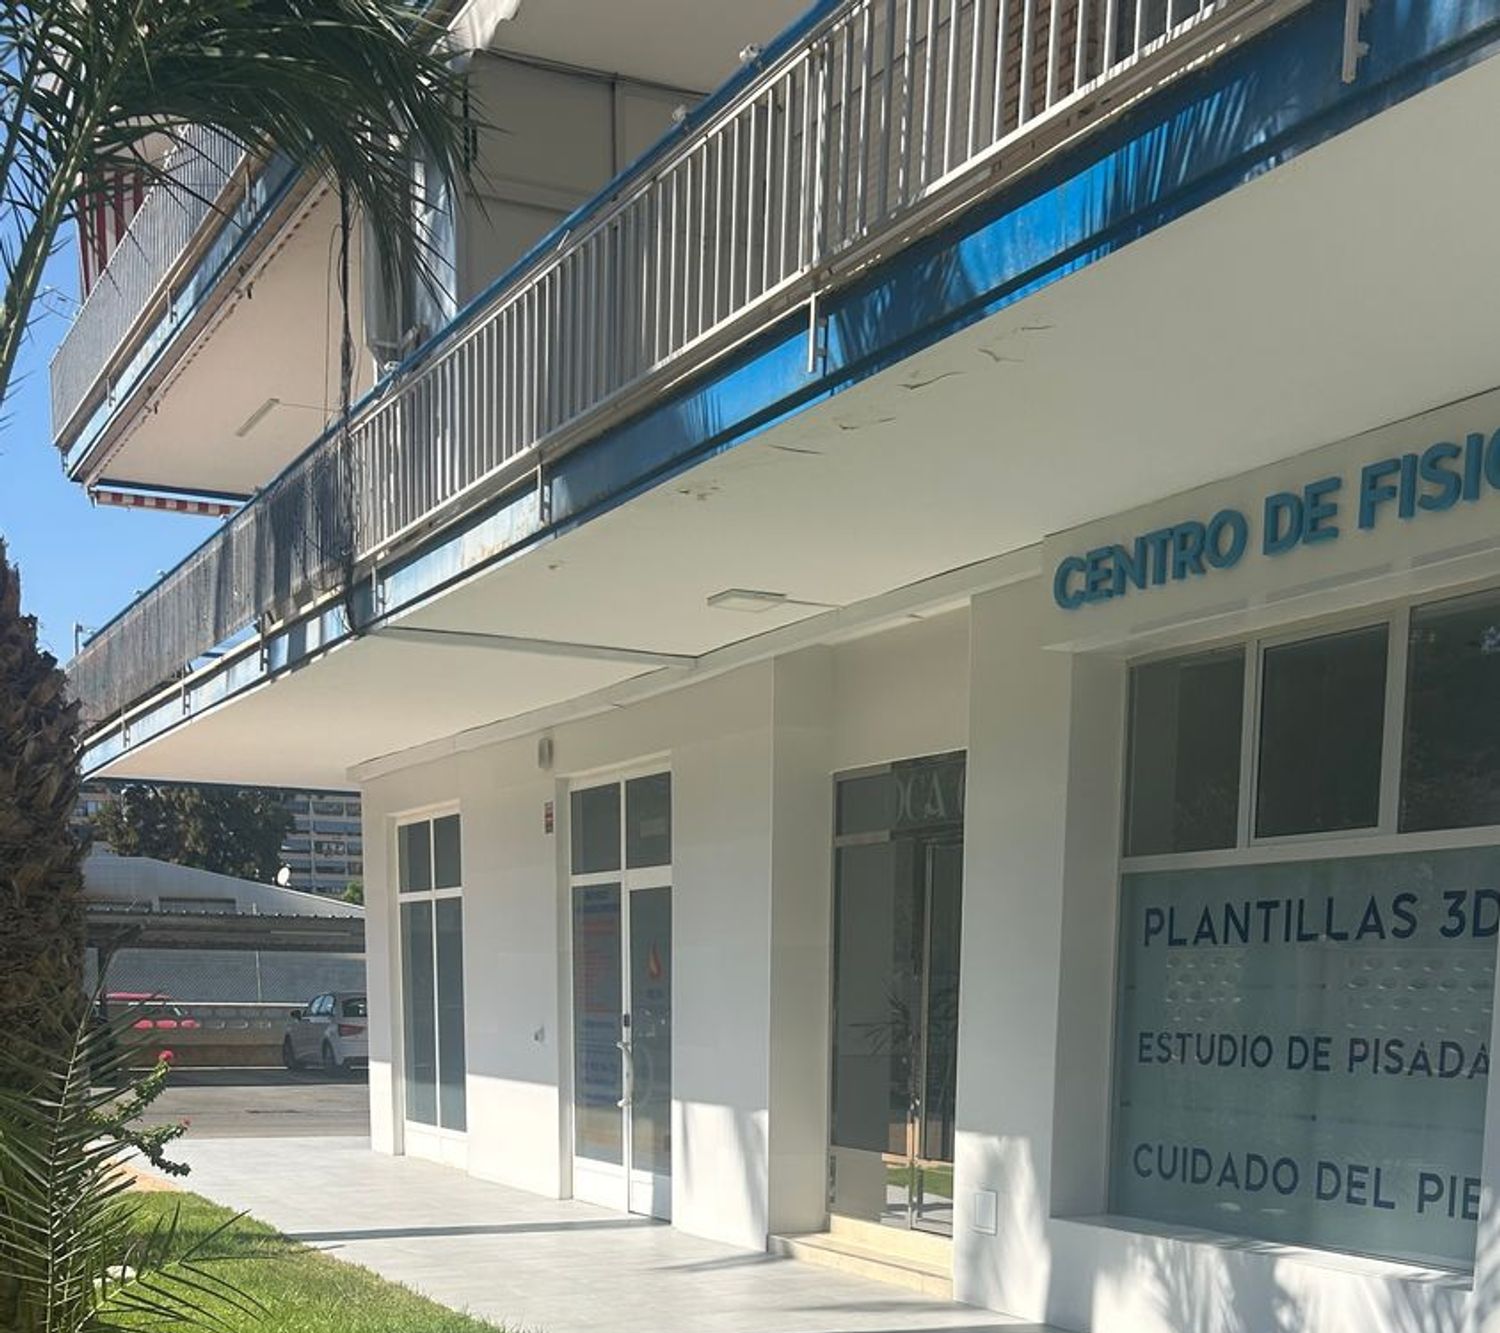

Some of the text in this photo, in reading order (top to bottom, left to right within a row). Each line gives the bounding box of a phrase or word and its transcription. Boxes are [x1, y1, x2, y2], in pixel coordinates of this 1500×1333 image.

[1053, 509, 1249, 609] CENTRO
[1262, 476, 1342, 556] DE
[1143, 889, 1500, 947] PLANTILLAS 3D
[1137, 1032, 1490, 1080] ESTUDIO DE PISADA
[1133, 1143, 1482, 1221] CUIDADO DEL PIE
